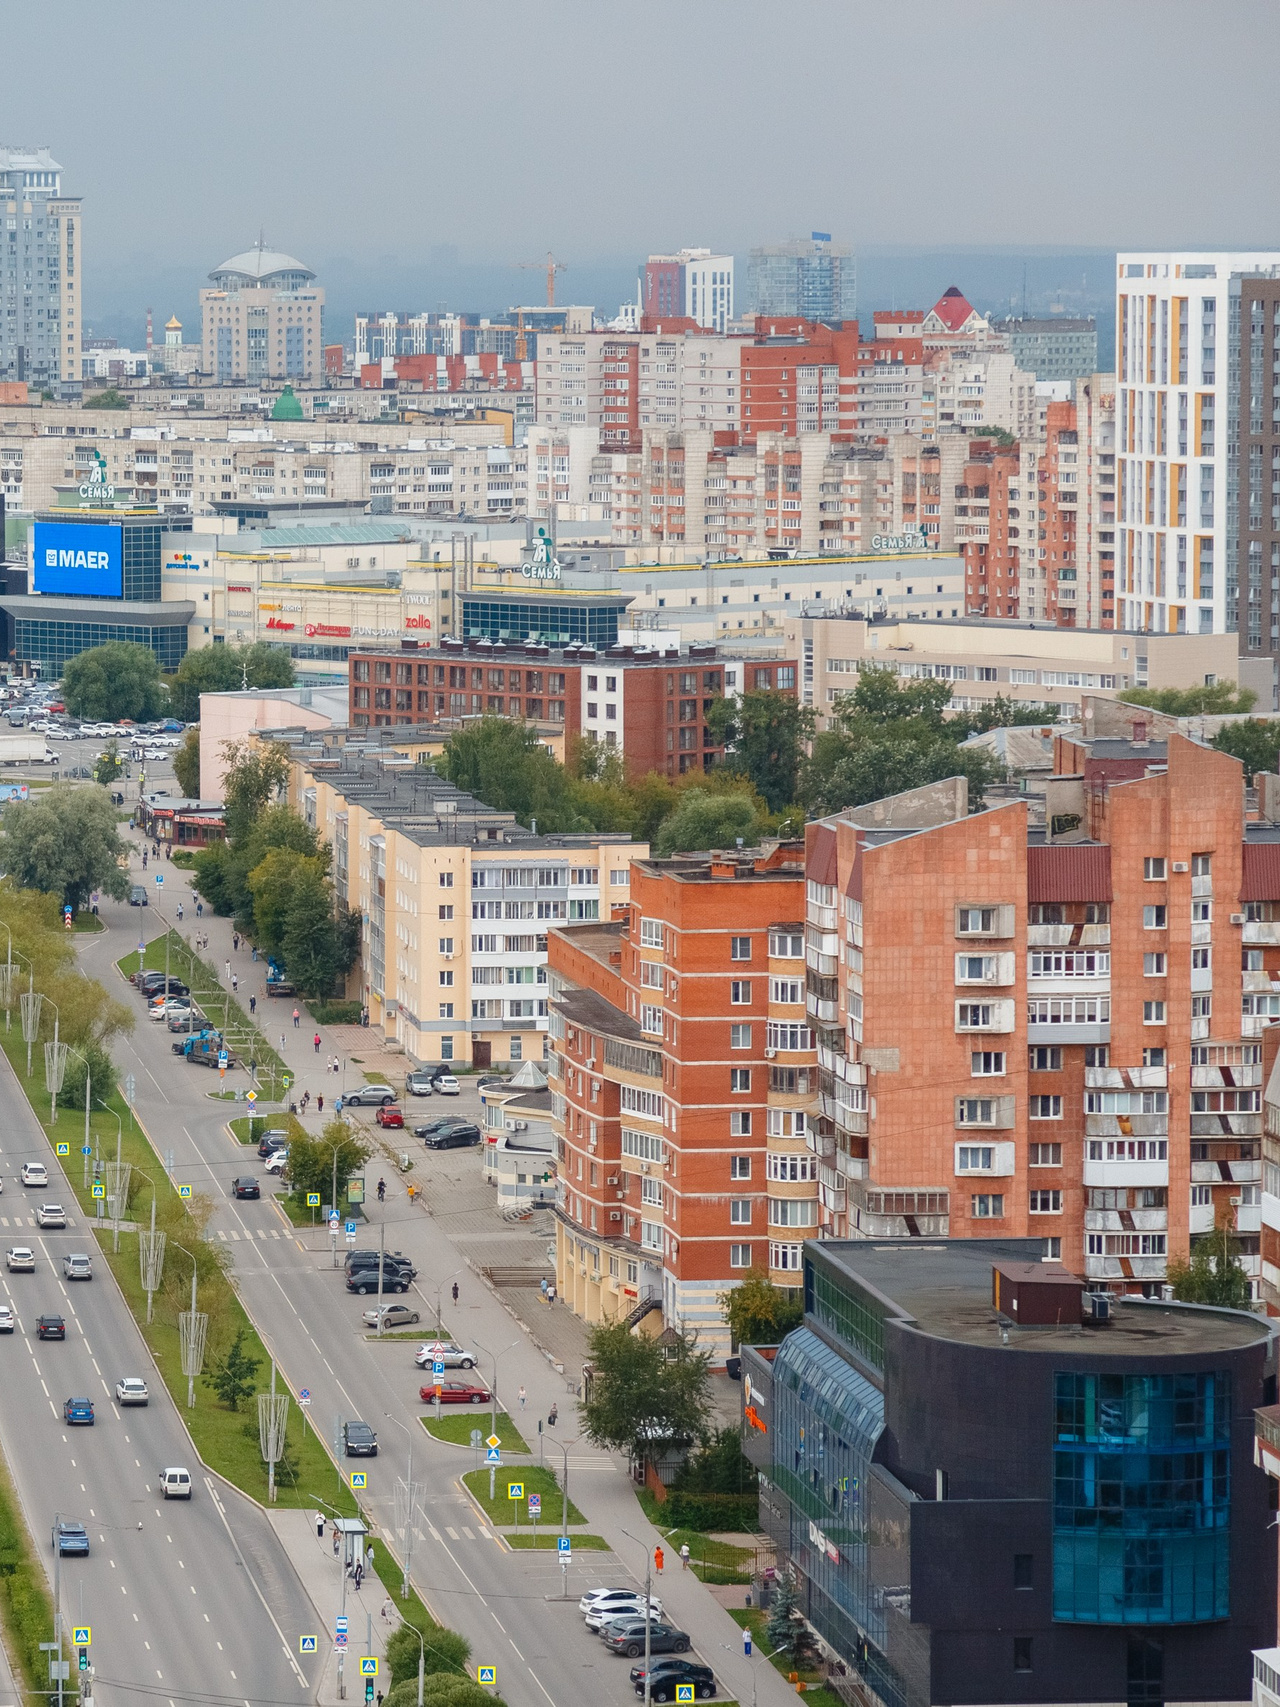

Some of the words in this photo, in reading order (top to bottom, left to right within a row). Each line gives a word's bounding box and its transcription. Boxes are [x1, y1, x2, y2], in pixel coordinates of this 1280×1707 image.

[59, 550, 109, 569] MAER
[405, 614, 431, 629] zolla
[352, 626, 371, 635] FUN
[380, 627, 400, 636] DAY
